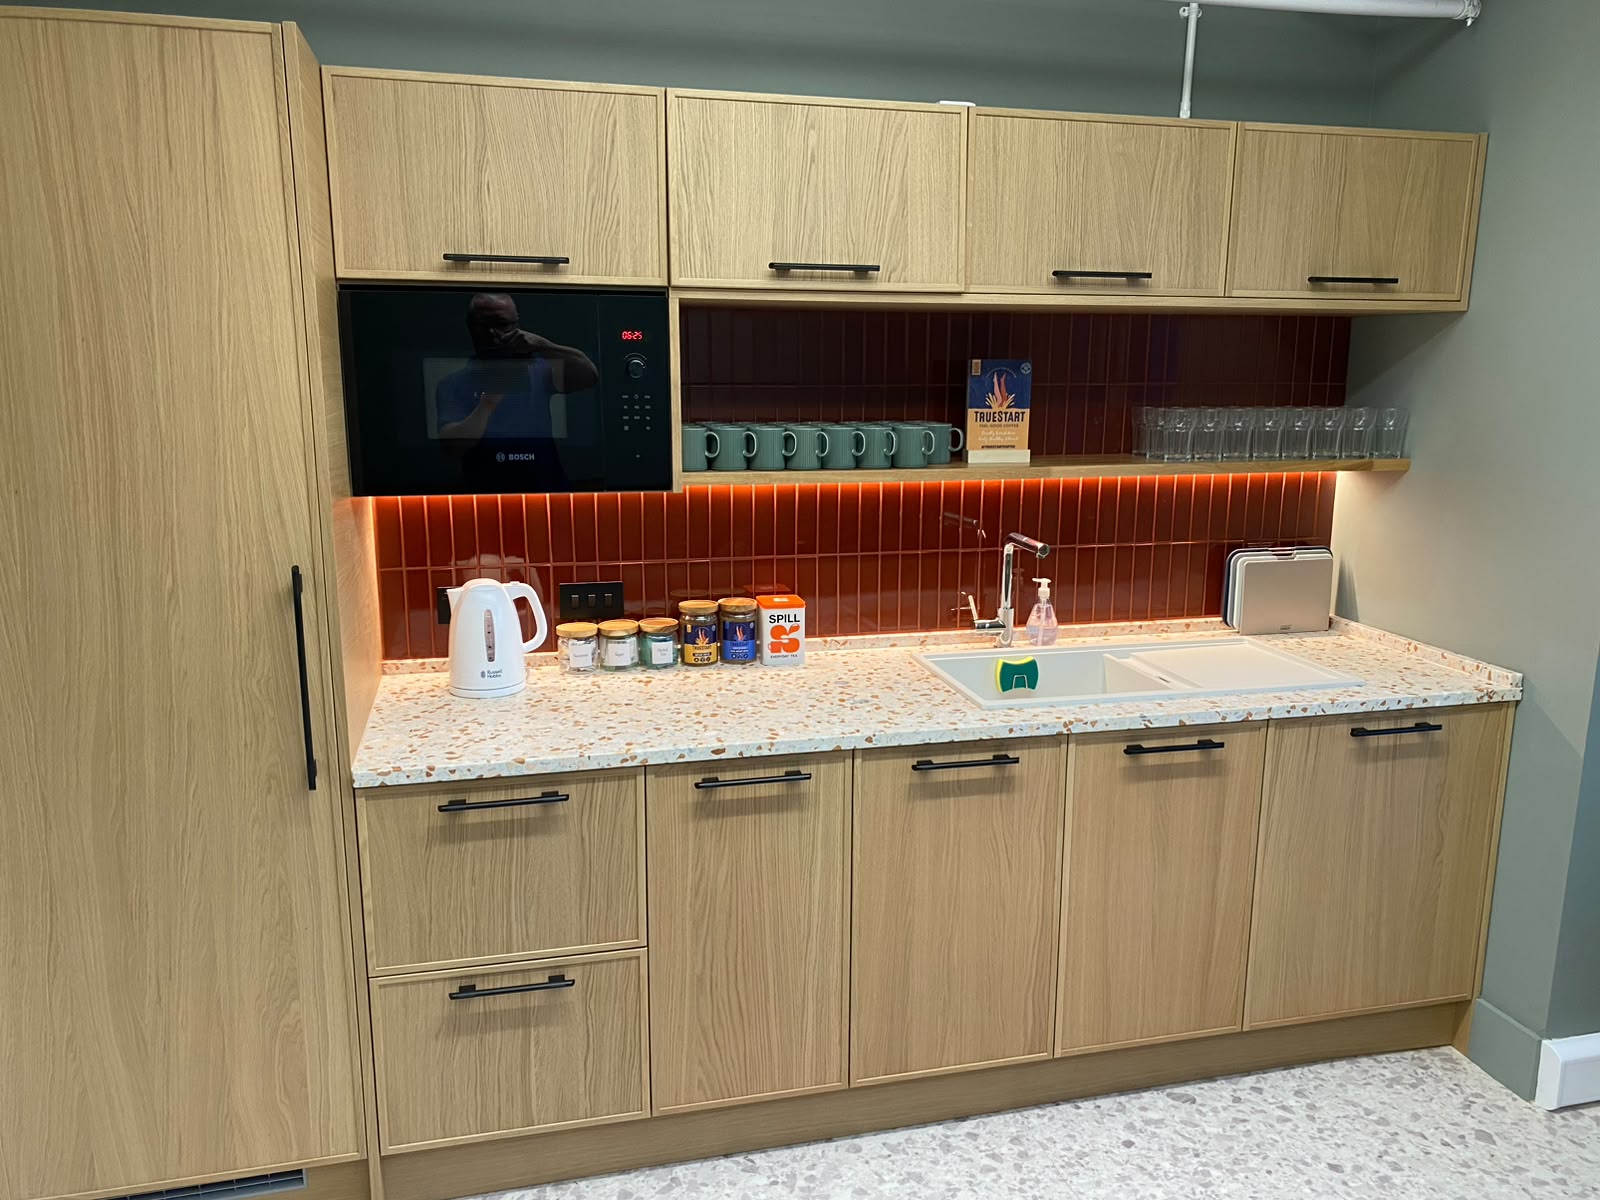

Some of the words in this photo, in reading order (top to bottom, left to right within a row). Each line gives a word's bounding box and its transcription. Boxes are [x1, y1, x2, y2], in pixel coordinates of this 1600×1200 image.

[974, 411, 1026, 423] TRUESTART
[508, 453, 535, 461] BOSCH
[769, 613, 800, 623] SPILL
